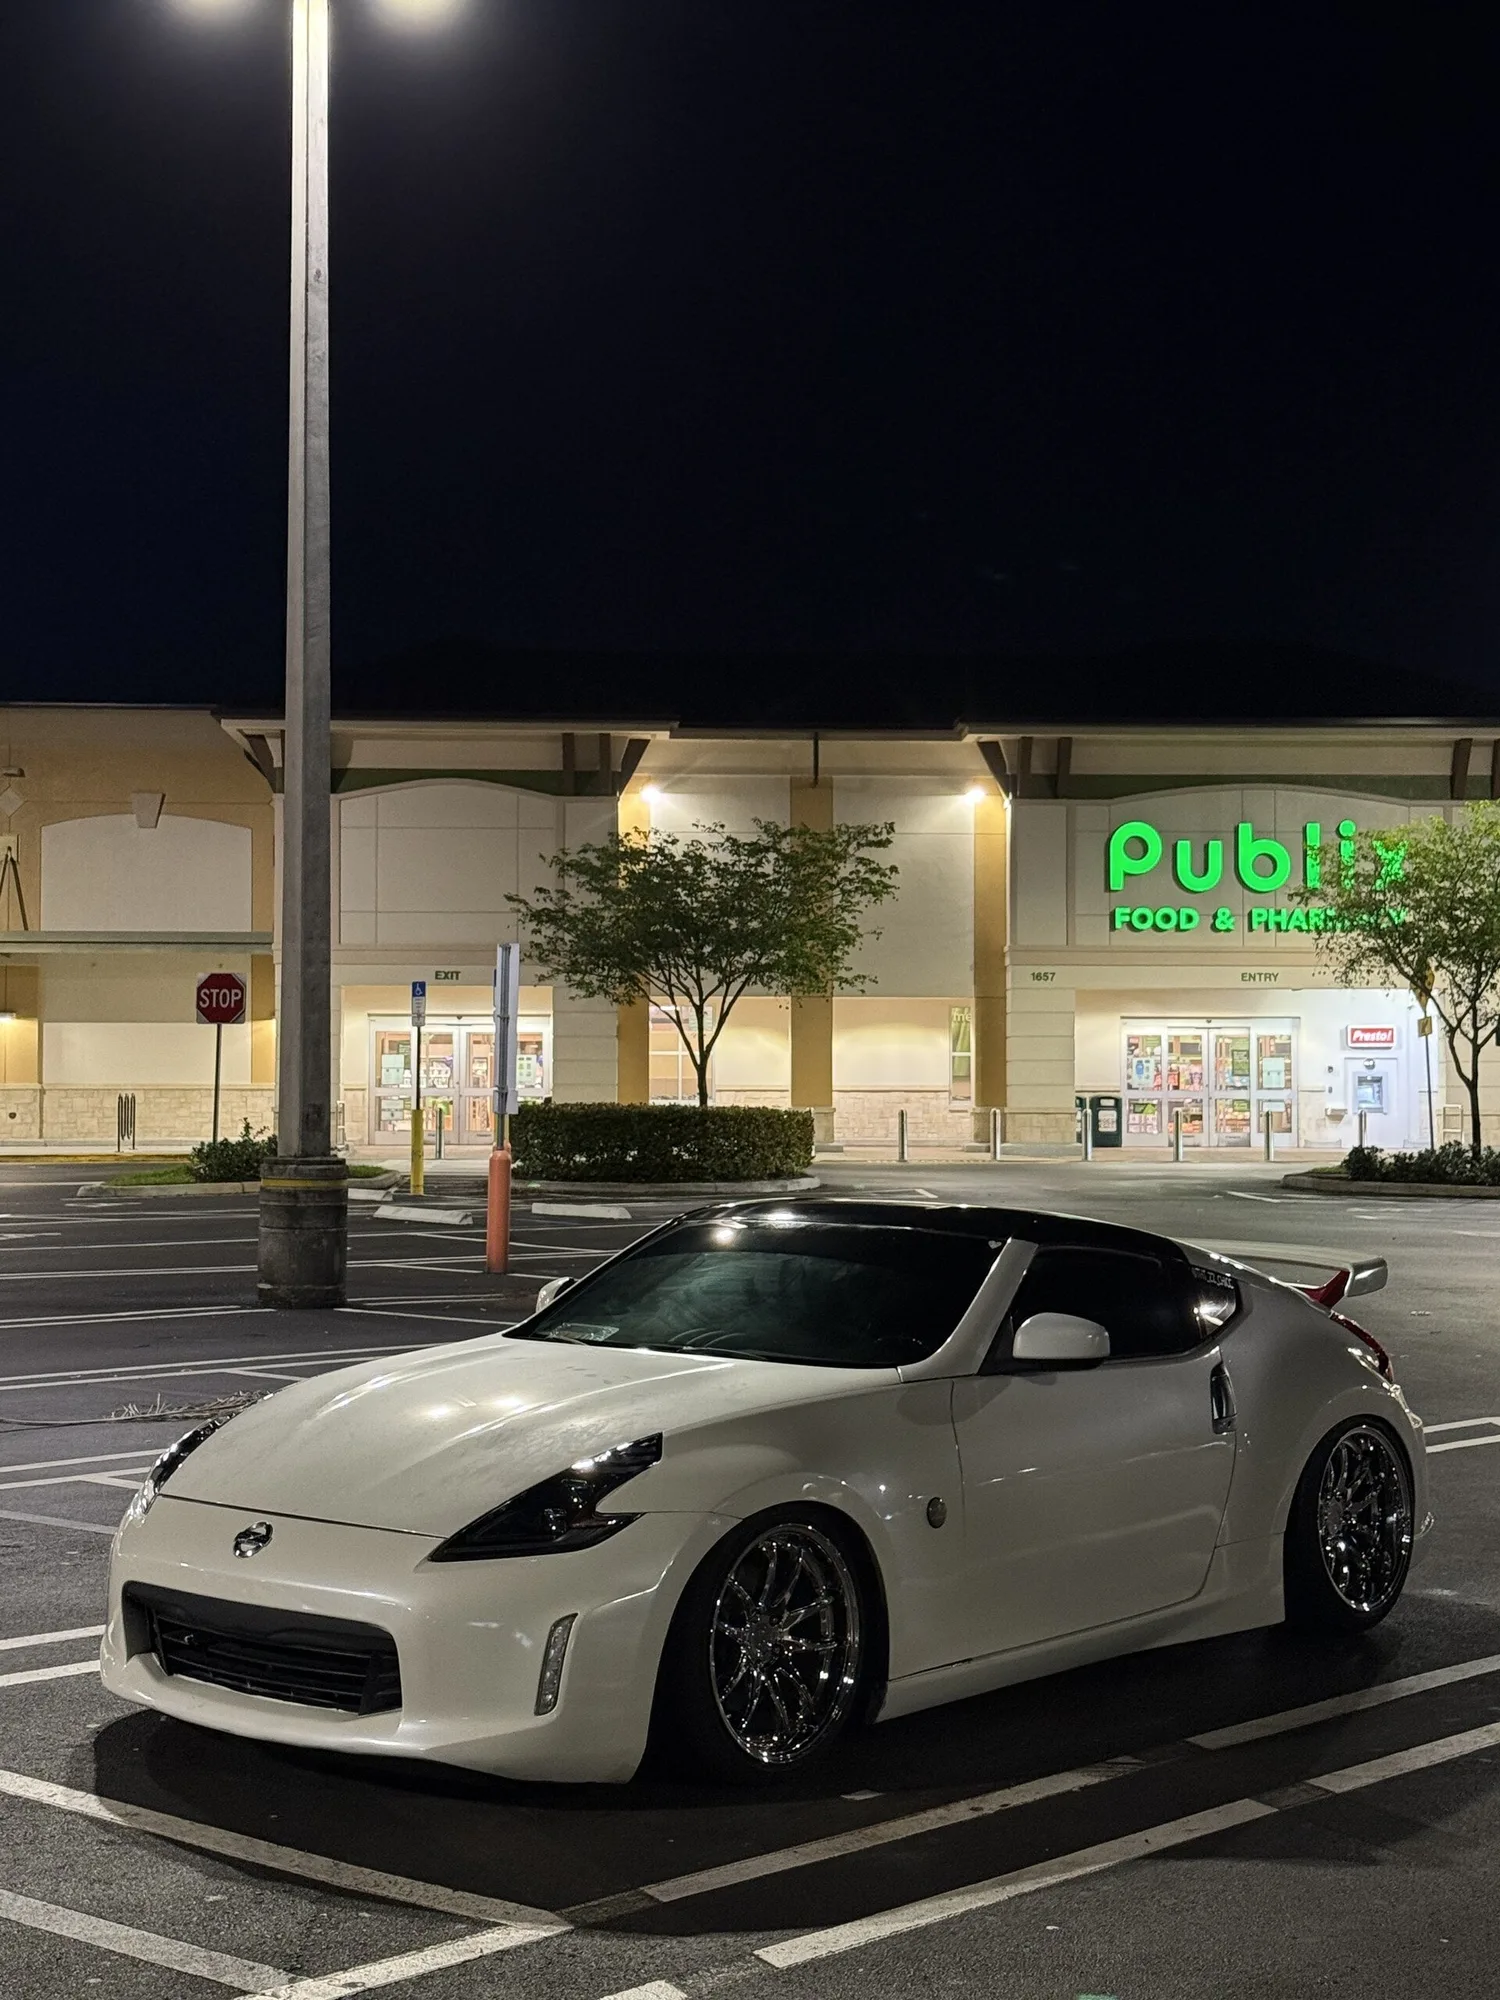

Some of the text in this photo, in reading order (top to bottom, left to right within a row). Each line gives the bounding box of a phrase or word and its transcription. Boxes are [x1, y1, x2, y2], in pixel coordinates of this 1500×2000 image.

[1109, 819, 1409, 892] Publix
[1113, 907, 1200, 931] FOOD
[1215, 907, 1234, 931] &
[434, 970, 461, 981] EXIT
[1030, 971, 1056, 982] 1657
[1240, 972, 1279, 982] ENTRY
[199, 988, 242, 1009] STOP
[1352, 1029, 1393, 1042] Presto!
